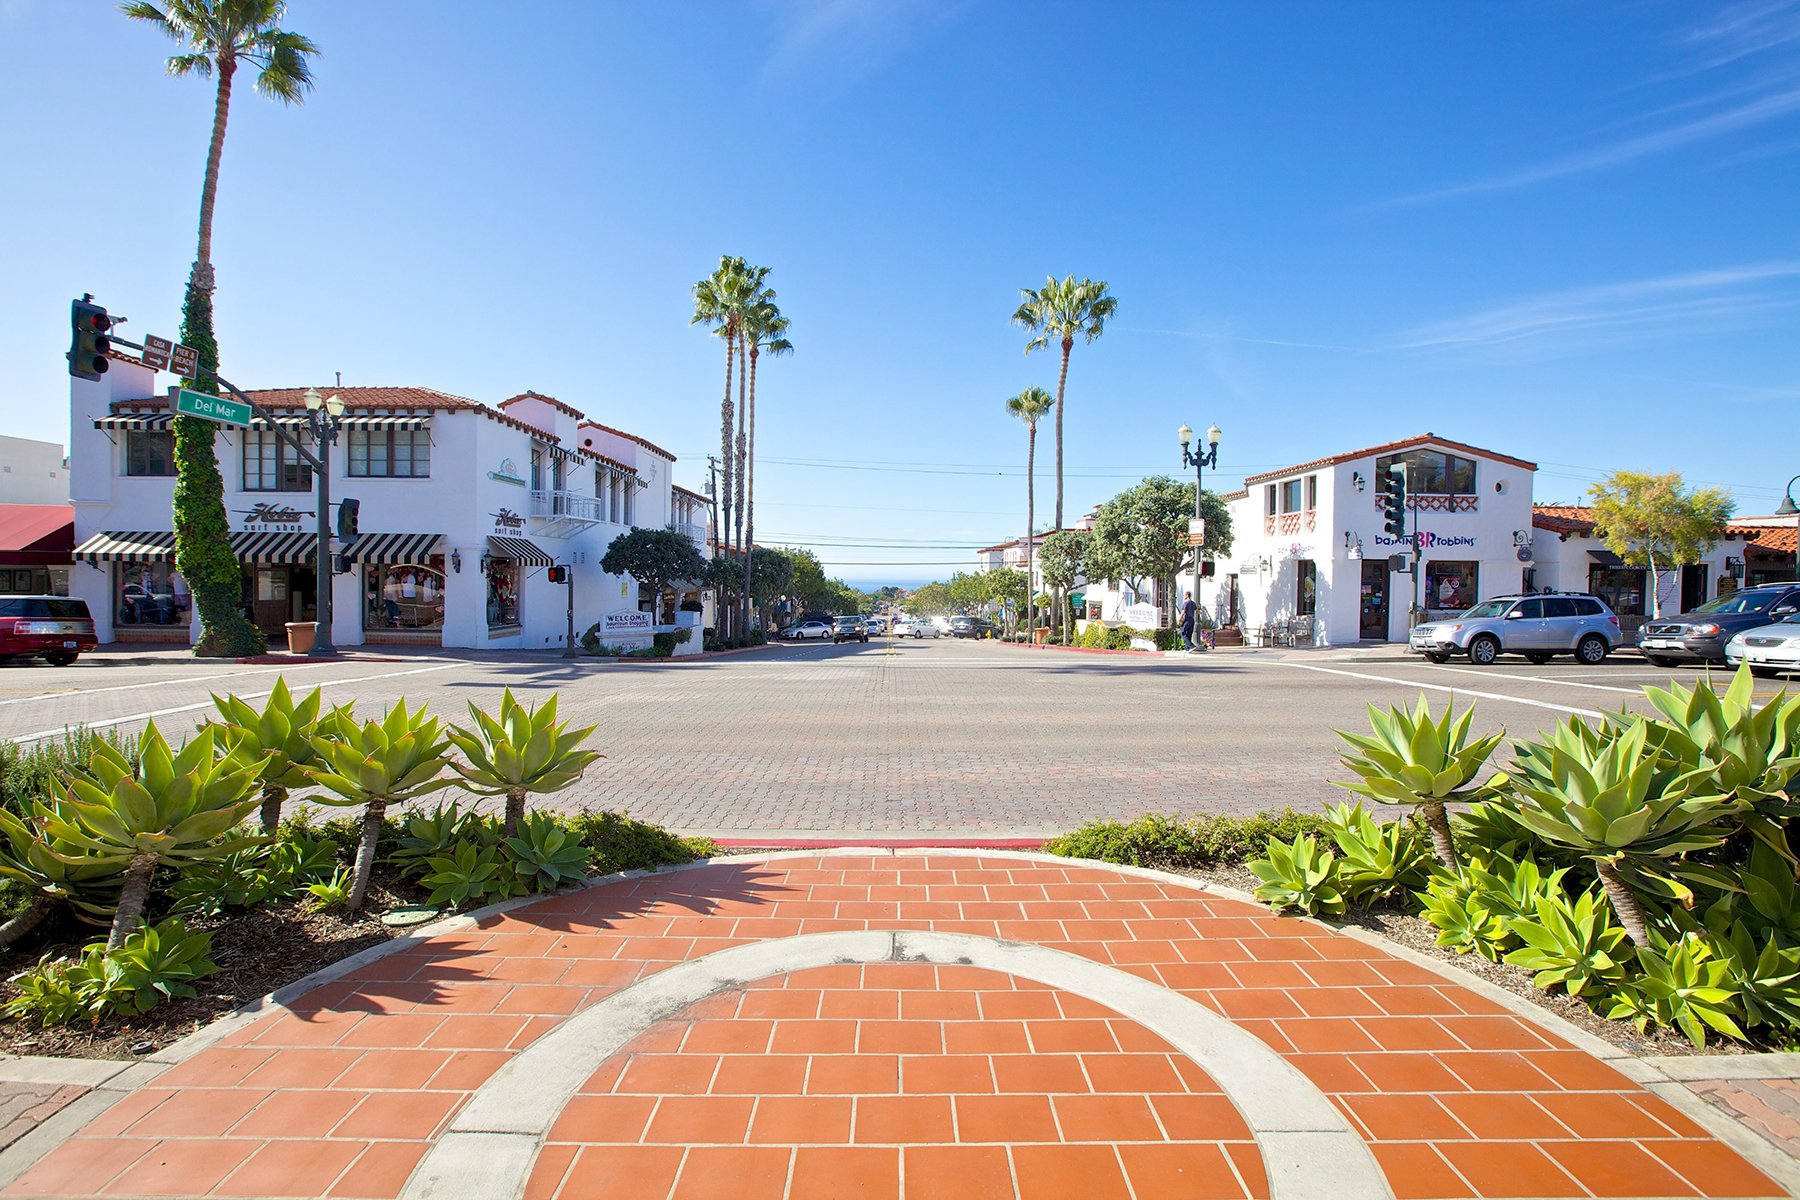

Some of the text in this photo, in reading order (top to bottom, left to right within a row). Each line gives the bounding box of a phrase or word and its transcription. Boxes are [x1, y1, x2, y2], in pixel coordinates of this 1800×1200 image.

[176, 347, 189, 356] PIER
[175, 355, 193, 367] BEACH
[195, 399, 236, 417] Del Mar
[276, 524, 302, 532] shop
